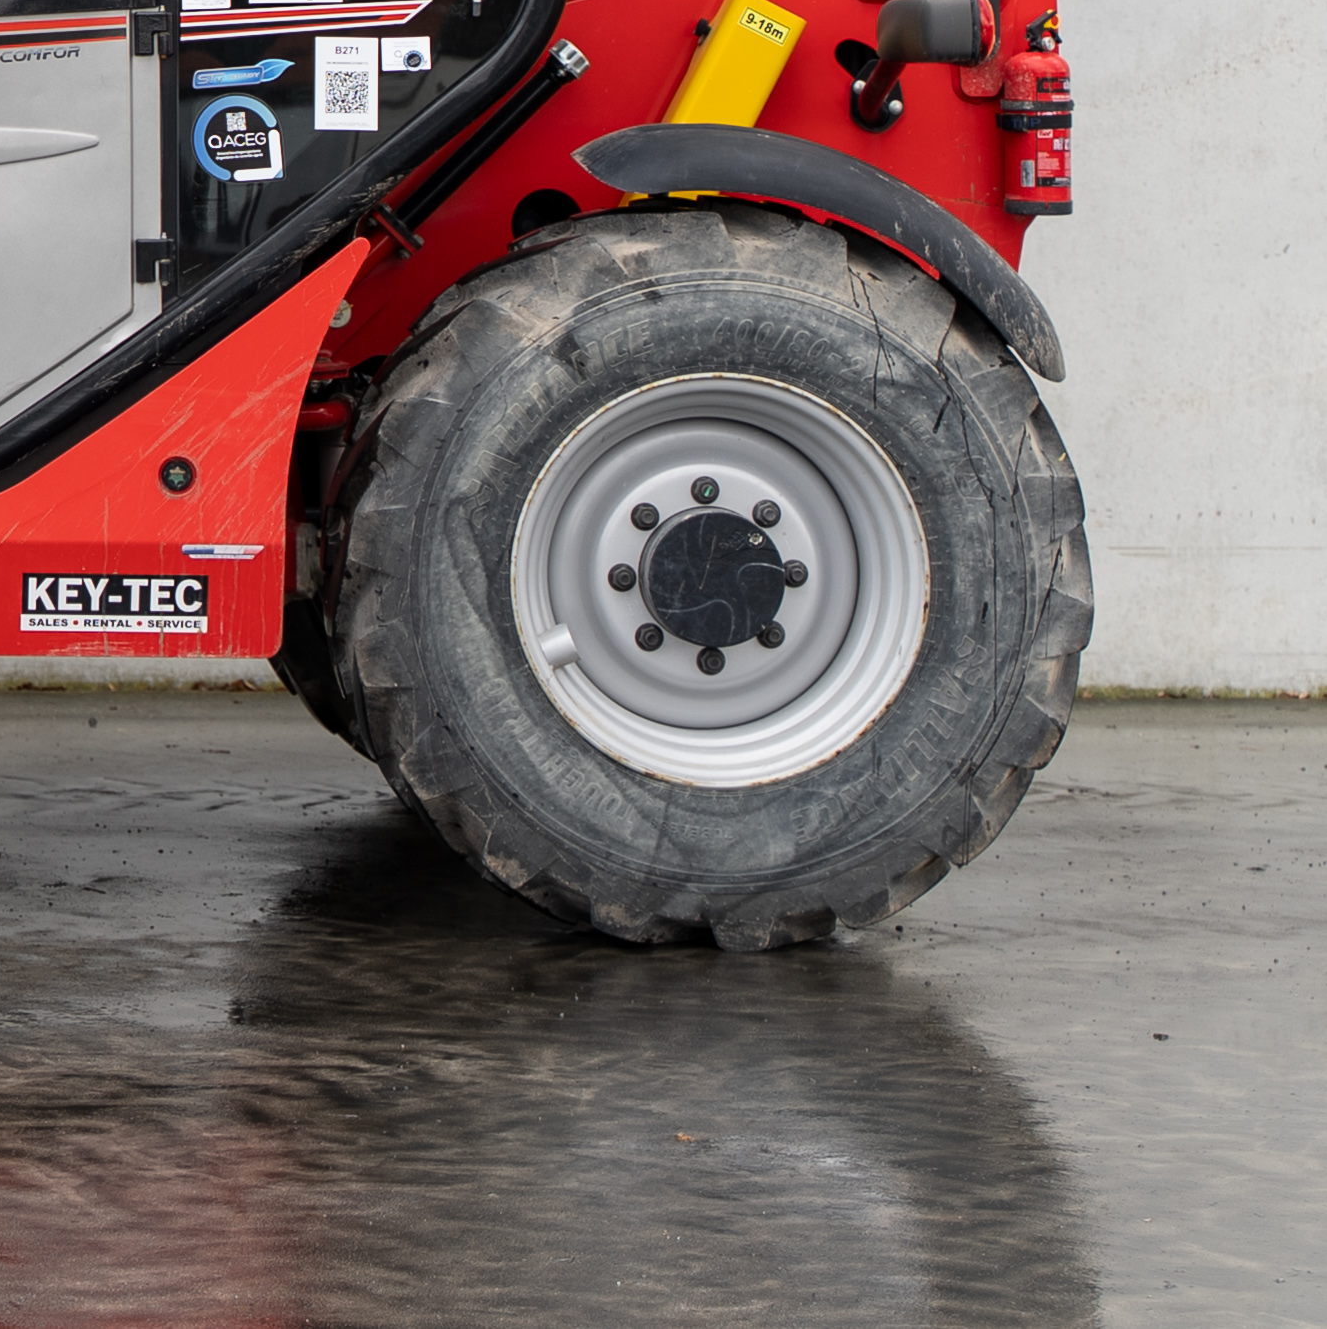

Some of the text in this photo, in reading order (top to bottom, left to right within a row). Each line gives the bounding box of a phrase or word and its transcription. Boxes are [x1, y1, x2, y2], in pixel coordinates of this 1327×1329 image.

[746, 13, 783, 39] 9-18m
[335, 46, 359, 54] B271
[472, 321, 656, 493] ALLIANCE
[27, 577, 203, 612] KEY-TEC
[29, 618, 201, 629] SALES RENTAL SERVICE
[787, 668, 973, 847] ALLIANCE
